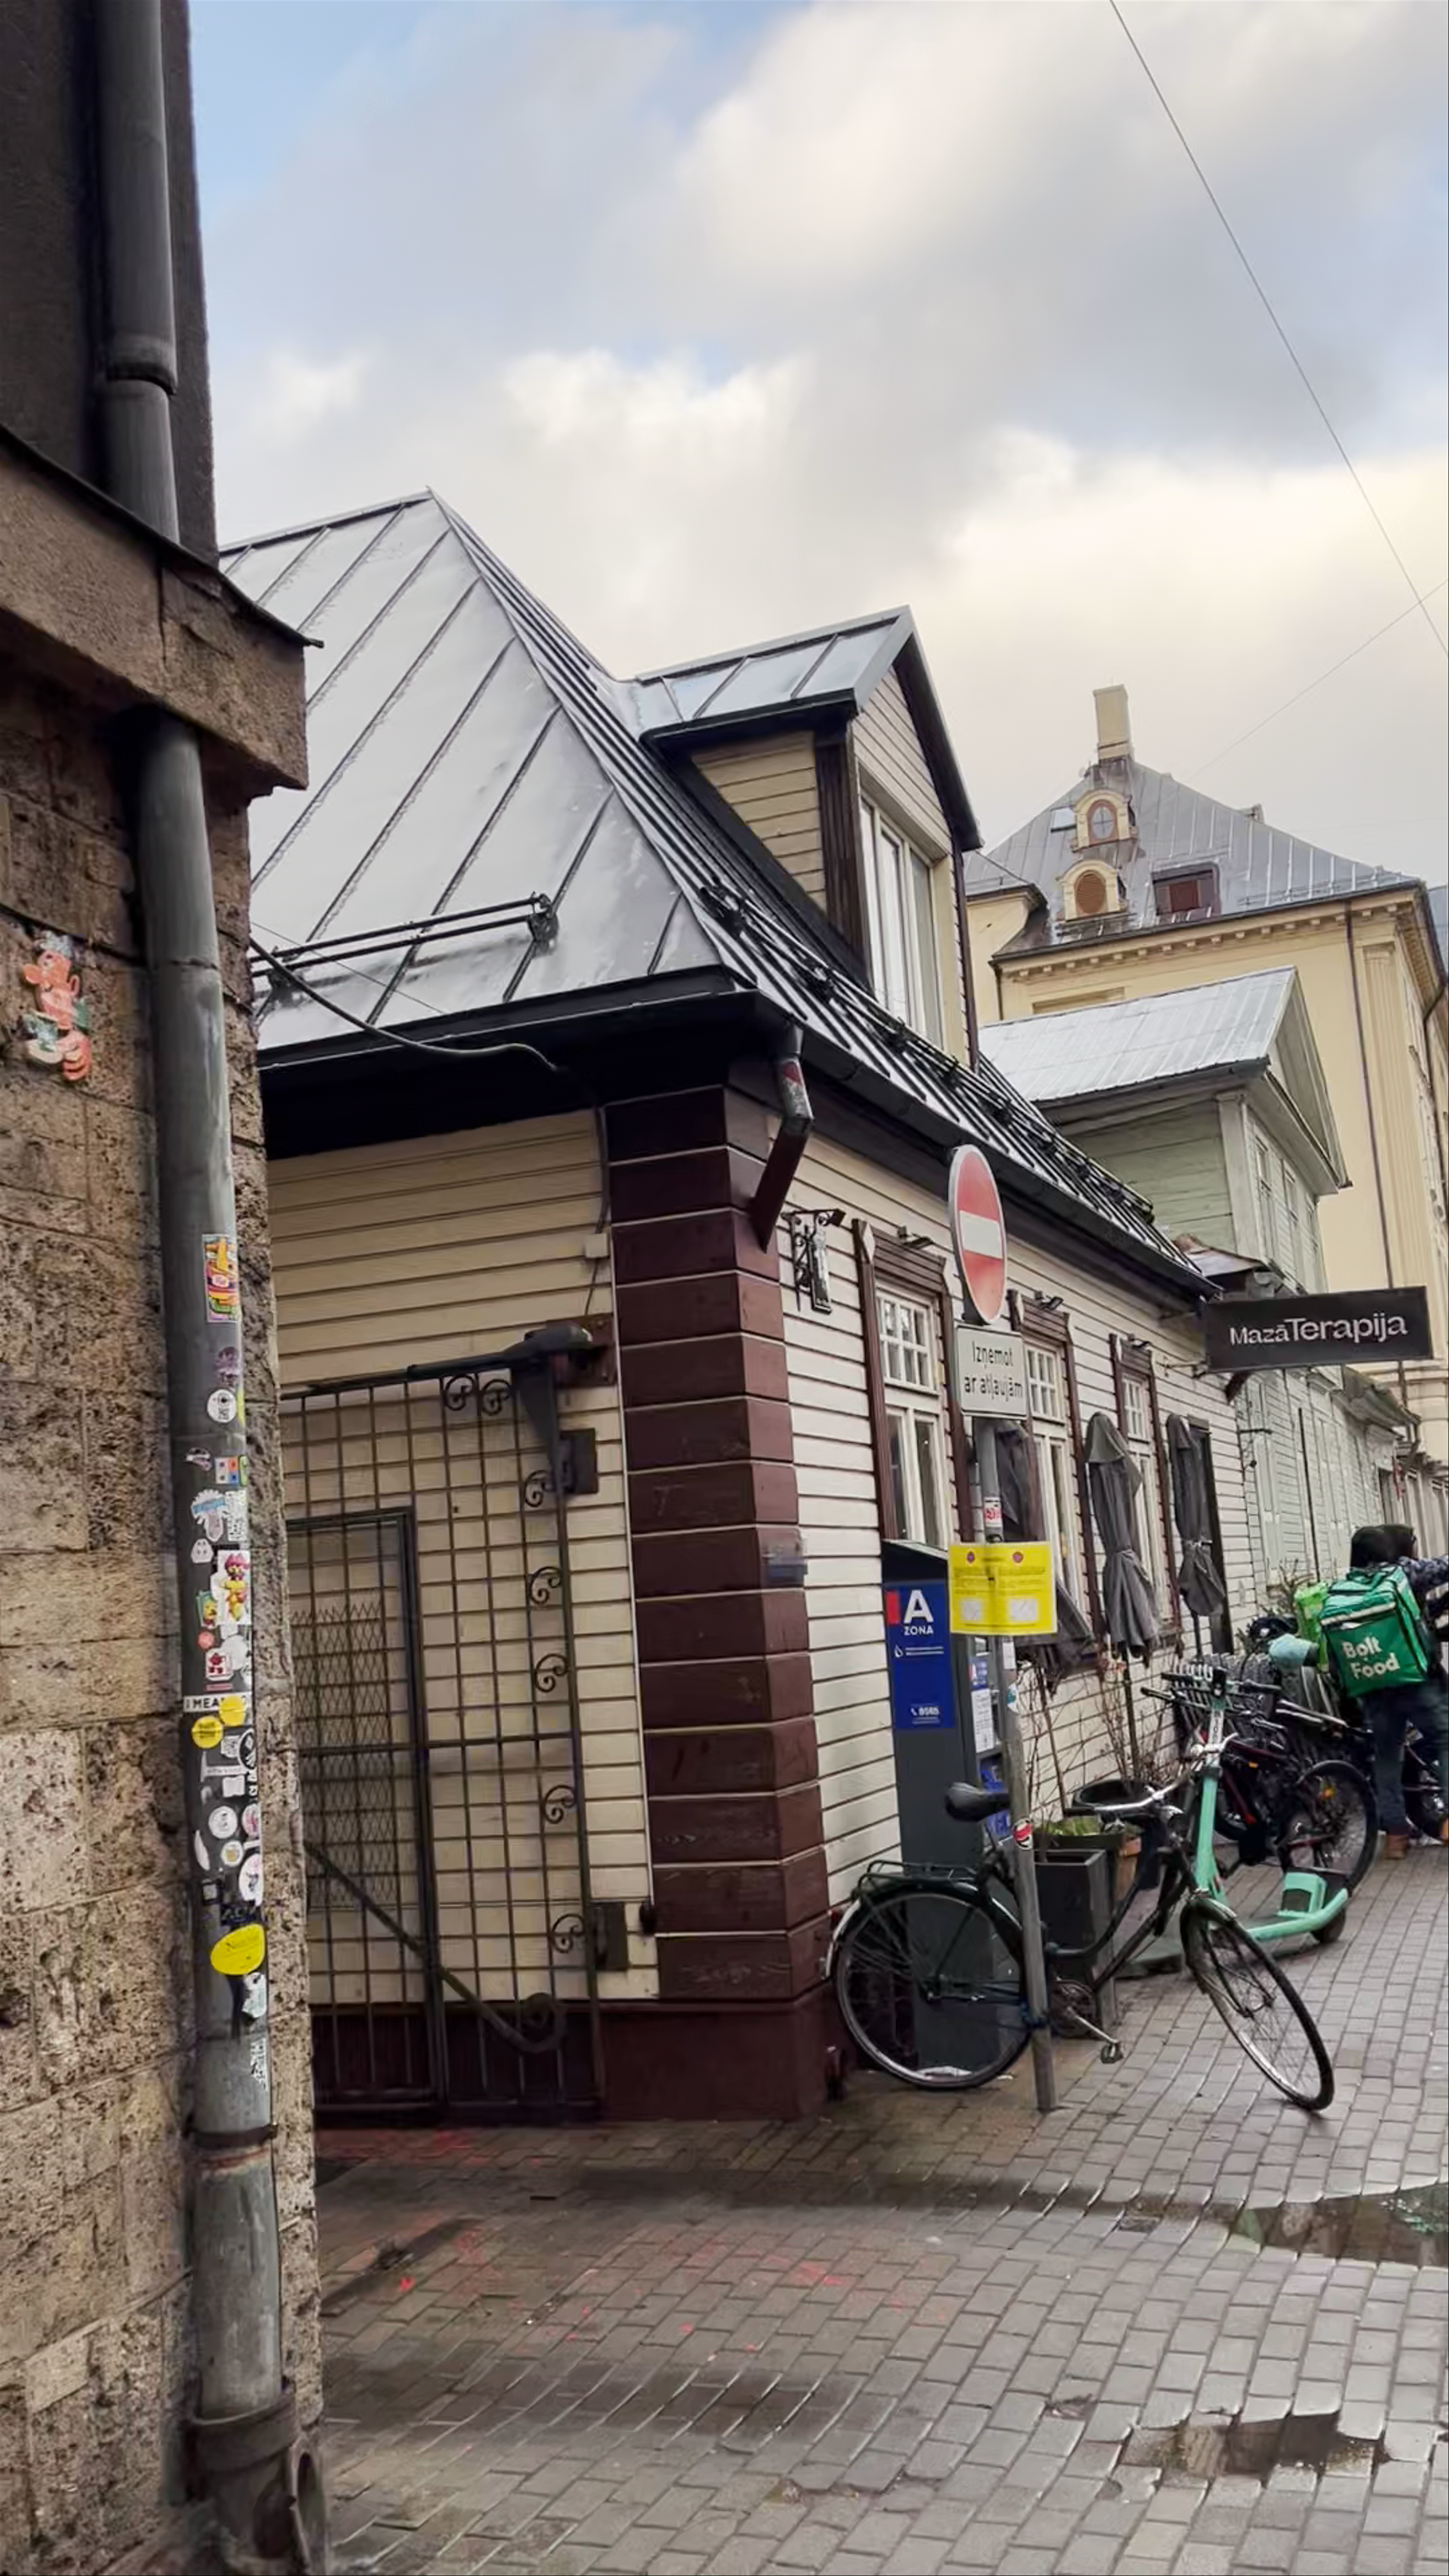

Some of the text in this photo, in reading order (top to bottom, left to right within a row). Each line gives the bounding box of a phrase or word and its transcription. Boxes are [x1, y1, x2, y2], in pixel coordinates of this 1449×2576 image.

[964, 1377, 976, 1393] ar
[904, 1589, 934, 1624] A
[904, 1625, 934, 1636] ZONA
[1343, 1636, 1383, 1658] Bolt
[1351, 1652, 1400, 1679] Food
